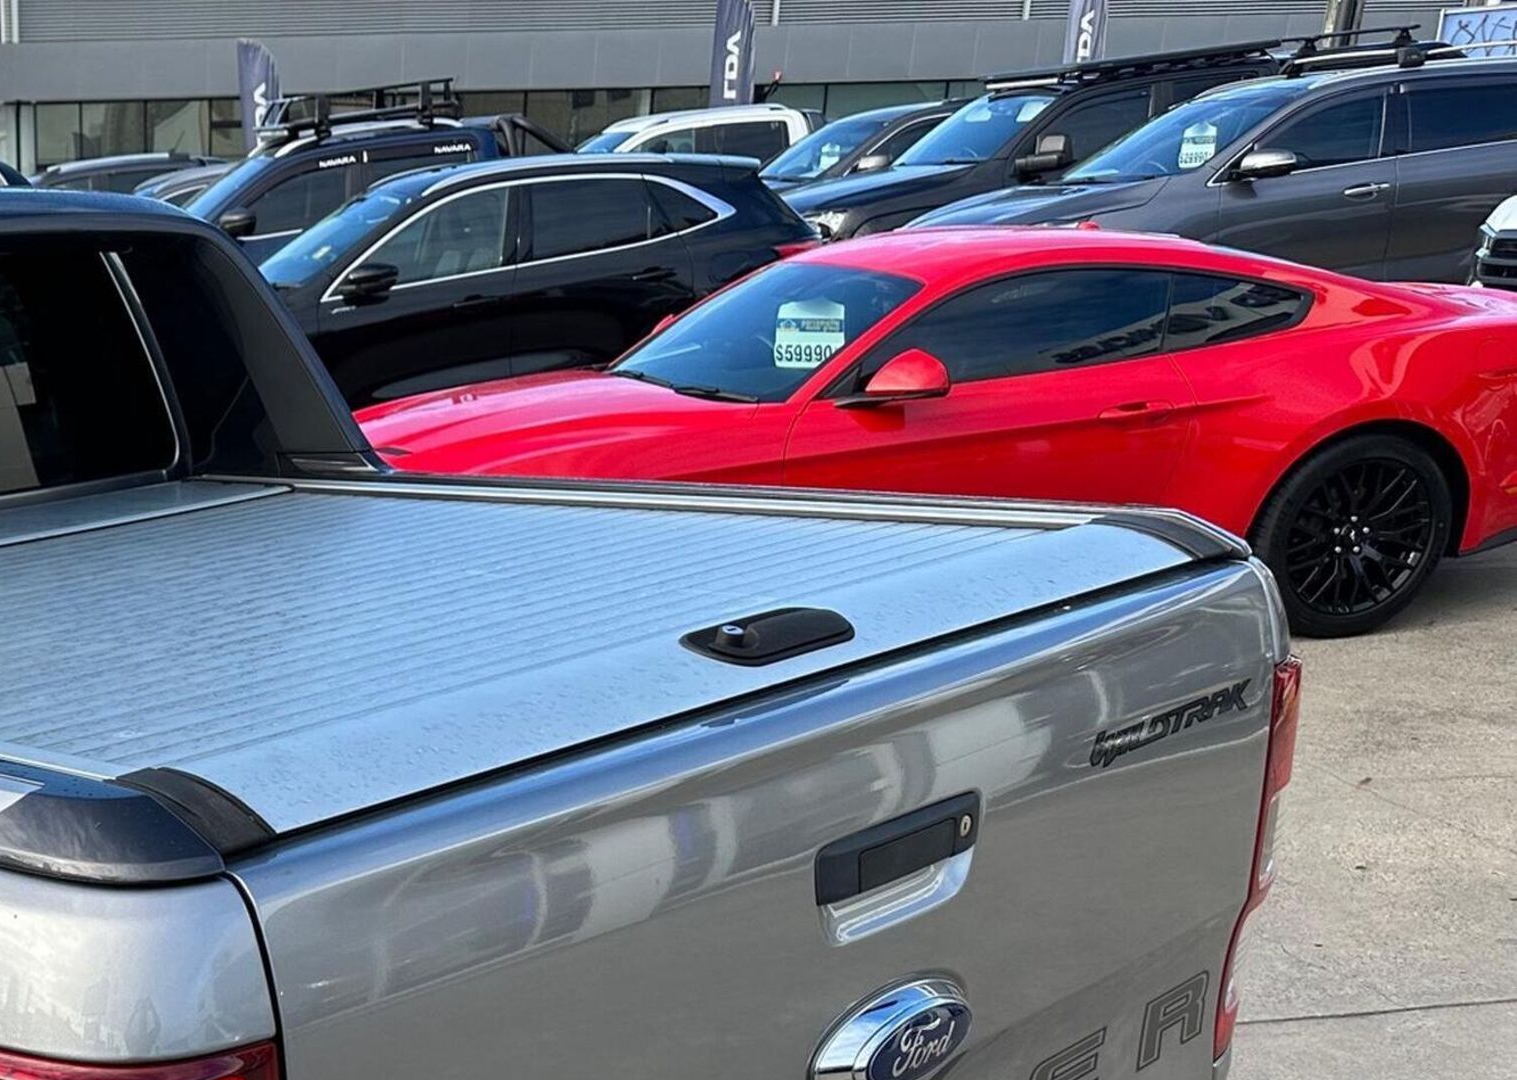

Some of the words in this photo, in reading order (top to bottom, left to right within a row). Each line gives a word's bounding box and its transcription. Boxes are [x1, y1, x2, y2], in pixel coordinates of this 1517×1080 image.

[723, 30, 741, 99] LDV
[319, 156, 357, 168] NAVARA
[434, 143, 471, 154] NAVARA
[776, 344, 833, 361] $59990
[1090, 678, 1252, 768] WILDTRAK
[892, 1016, 955, 1078] Ford
